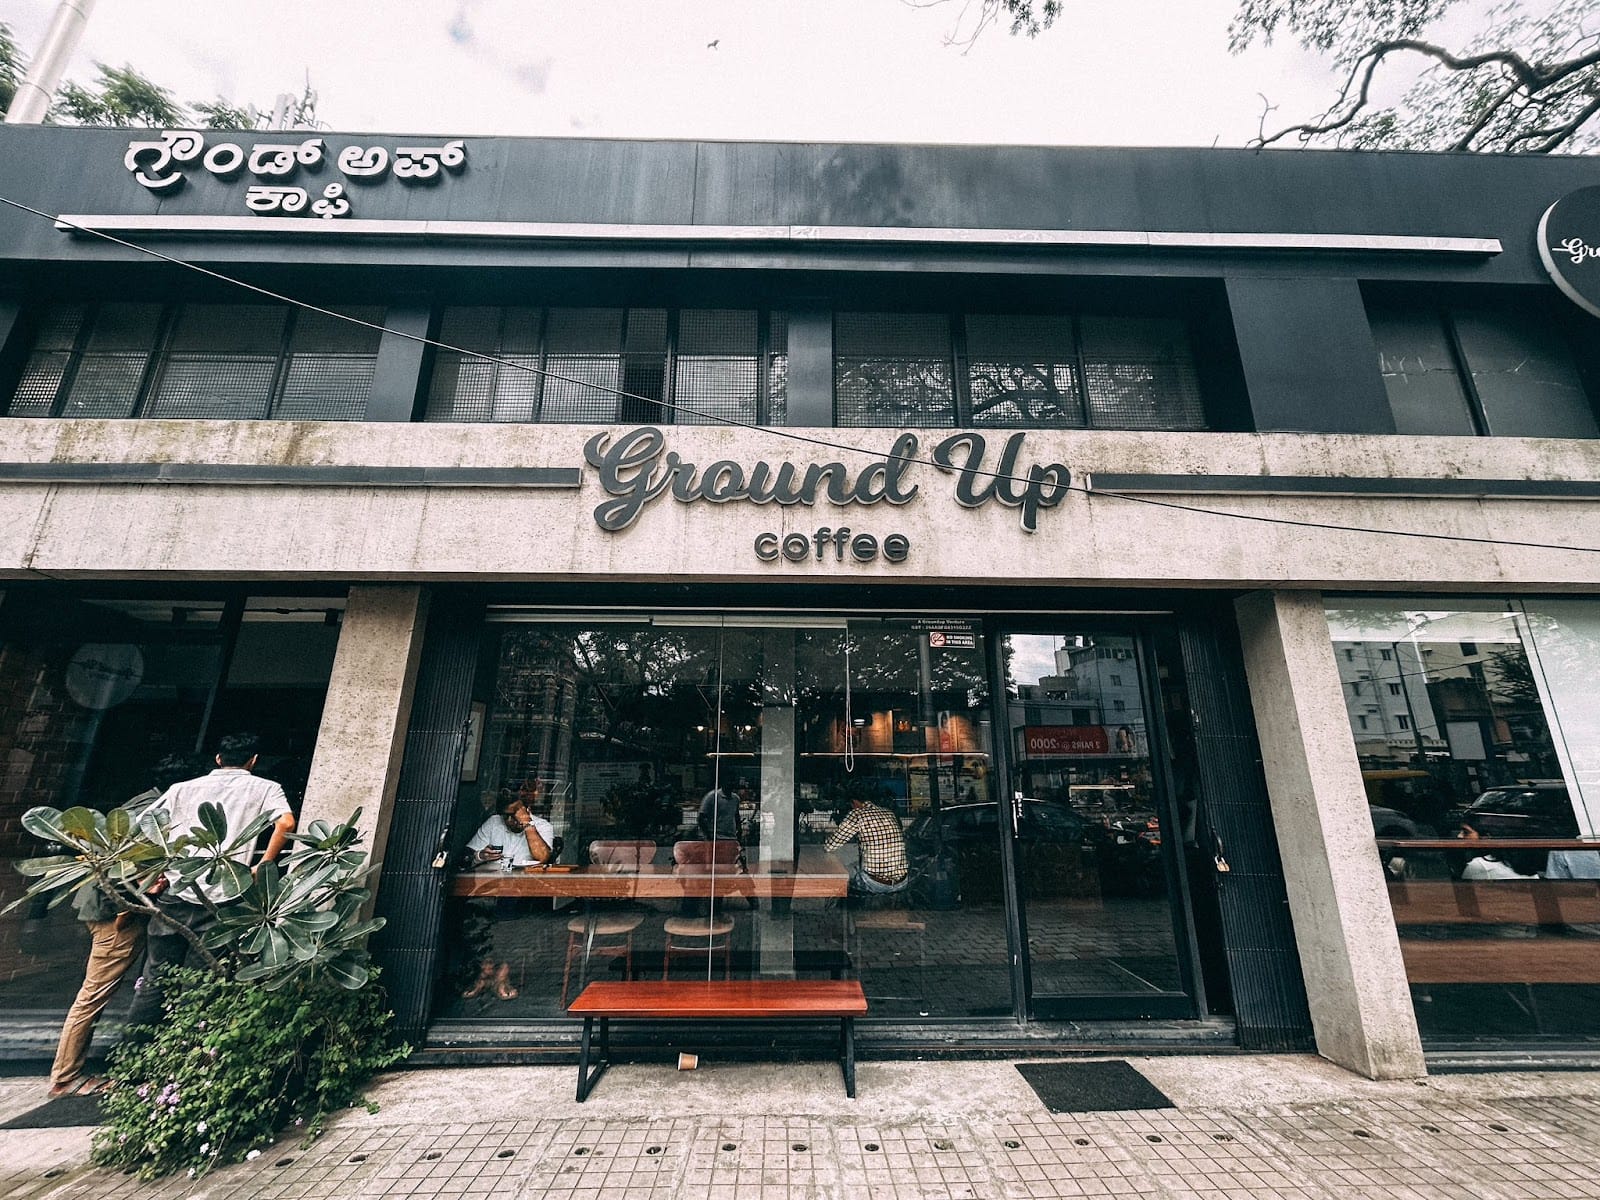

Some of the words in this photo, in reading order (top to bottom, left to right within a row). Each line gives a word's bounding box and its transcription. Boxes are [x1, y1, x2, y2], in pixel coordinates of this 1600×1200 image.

[338, 140, 465, 178] ಅಪ್
[246, 183, 350, 219] ಕಾಫಿ
[583, 426, 919, 531] Ground
[931, 431, 1072, 533] Up
[754, 527, 910, 563] coffee
